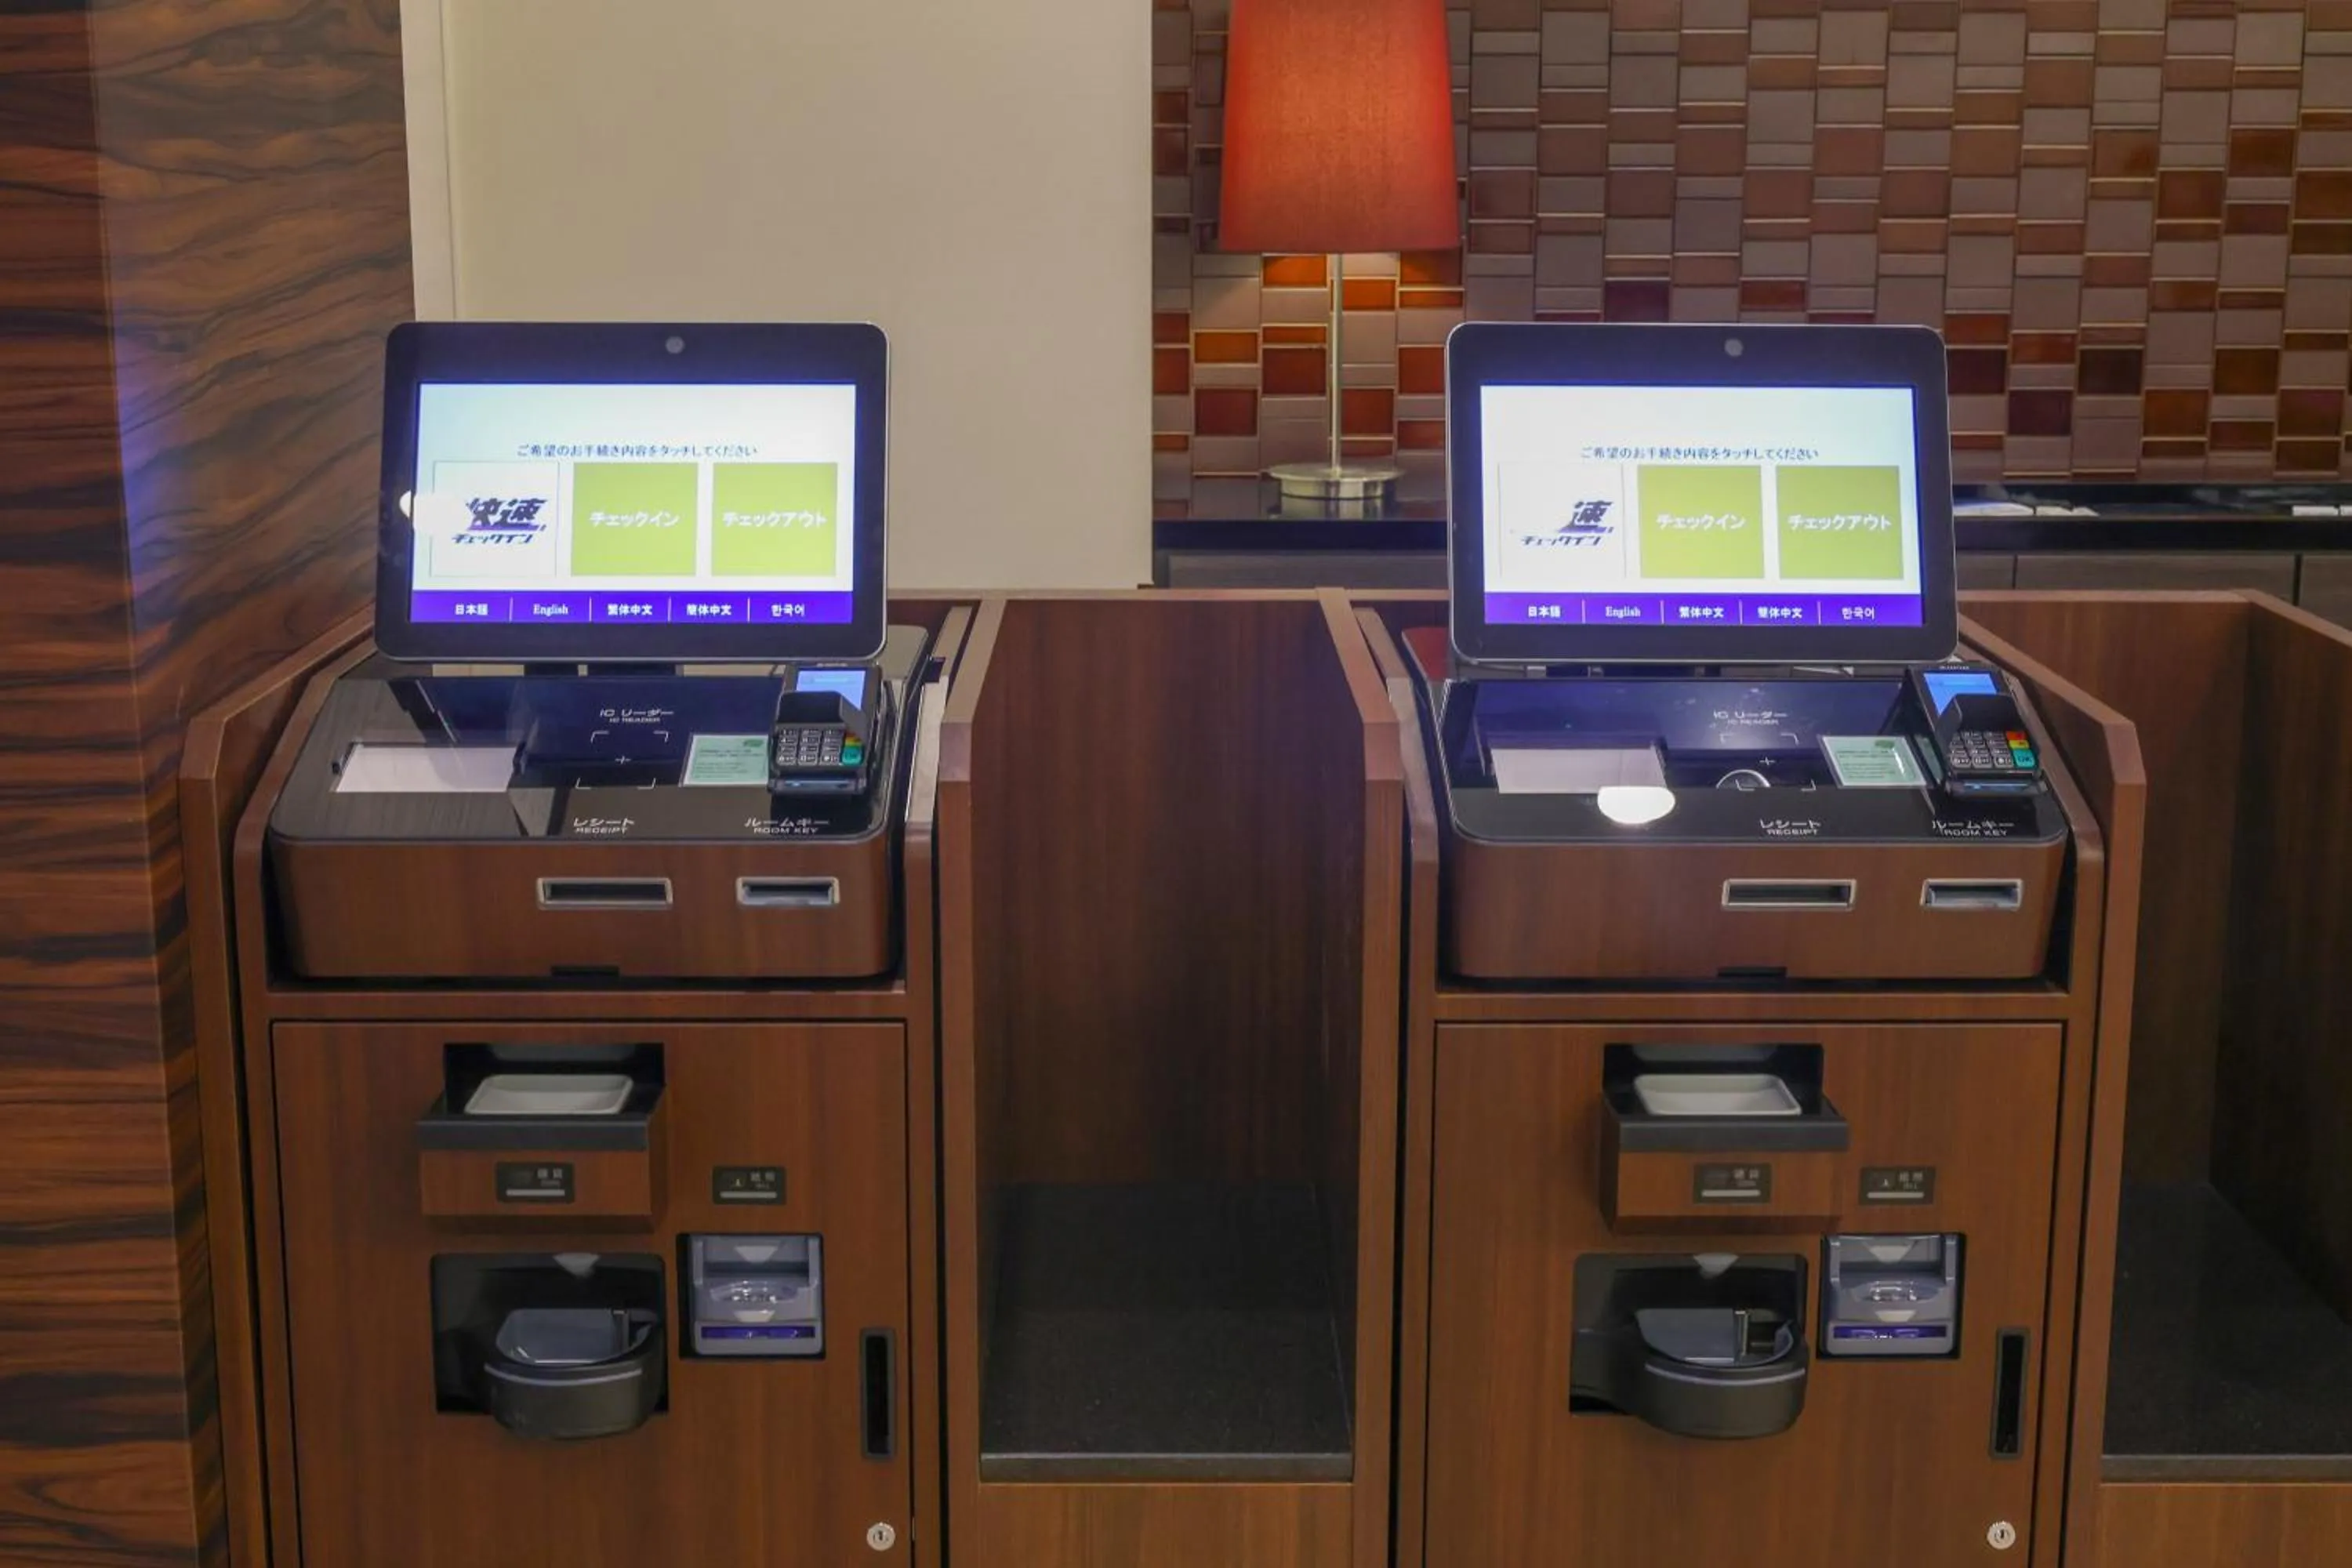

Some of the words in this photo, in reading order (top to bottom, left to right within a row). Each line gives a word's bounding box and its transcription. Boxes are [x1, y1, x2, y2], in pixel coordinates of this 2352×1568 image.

[517, 443, 758, 457] ご希望のお手続き内容をタッチしてください
[1581, 447, 1819, 459] ご希望のお手続き内容をタッチしてください
[466, 497, 547, 532] 快速
[590, 511, 680, 527] チェックイン
[722, 511, 827, 527] チェックアウト
[1557, 499, 1613, 533] 速
[1656, 514, 1745, 530] チェックイン
[1788, 514, 1892, 531] チェックアウト
[455, 604, 488, 615] 日本語
[532, 604, 568, 616] English
[771, 604, 805, 617] 한국어
[1528, 605, 1561, 618] 日本語
[1605, 606, 1641, 618] English
[1842, 607, 1875, 620] 한국어
[573, 818, 634, 826] レシート
[744, 818, 829, 827] ルームキー
[1759, 818, 1821, 829] レシート
[1932, 820, 2014, 829] ルームキー
